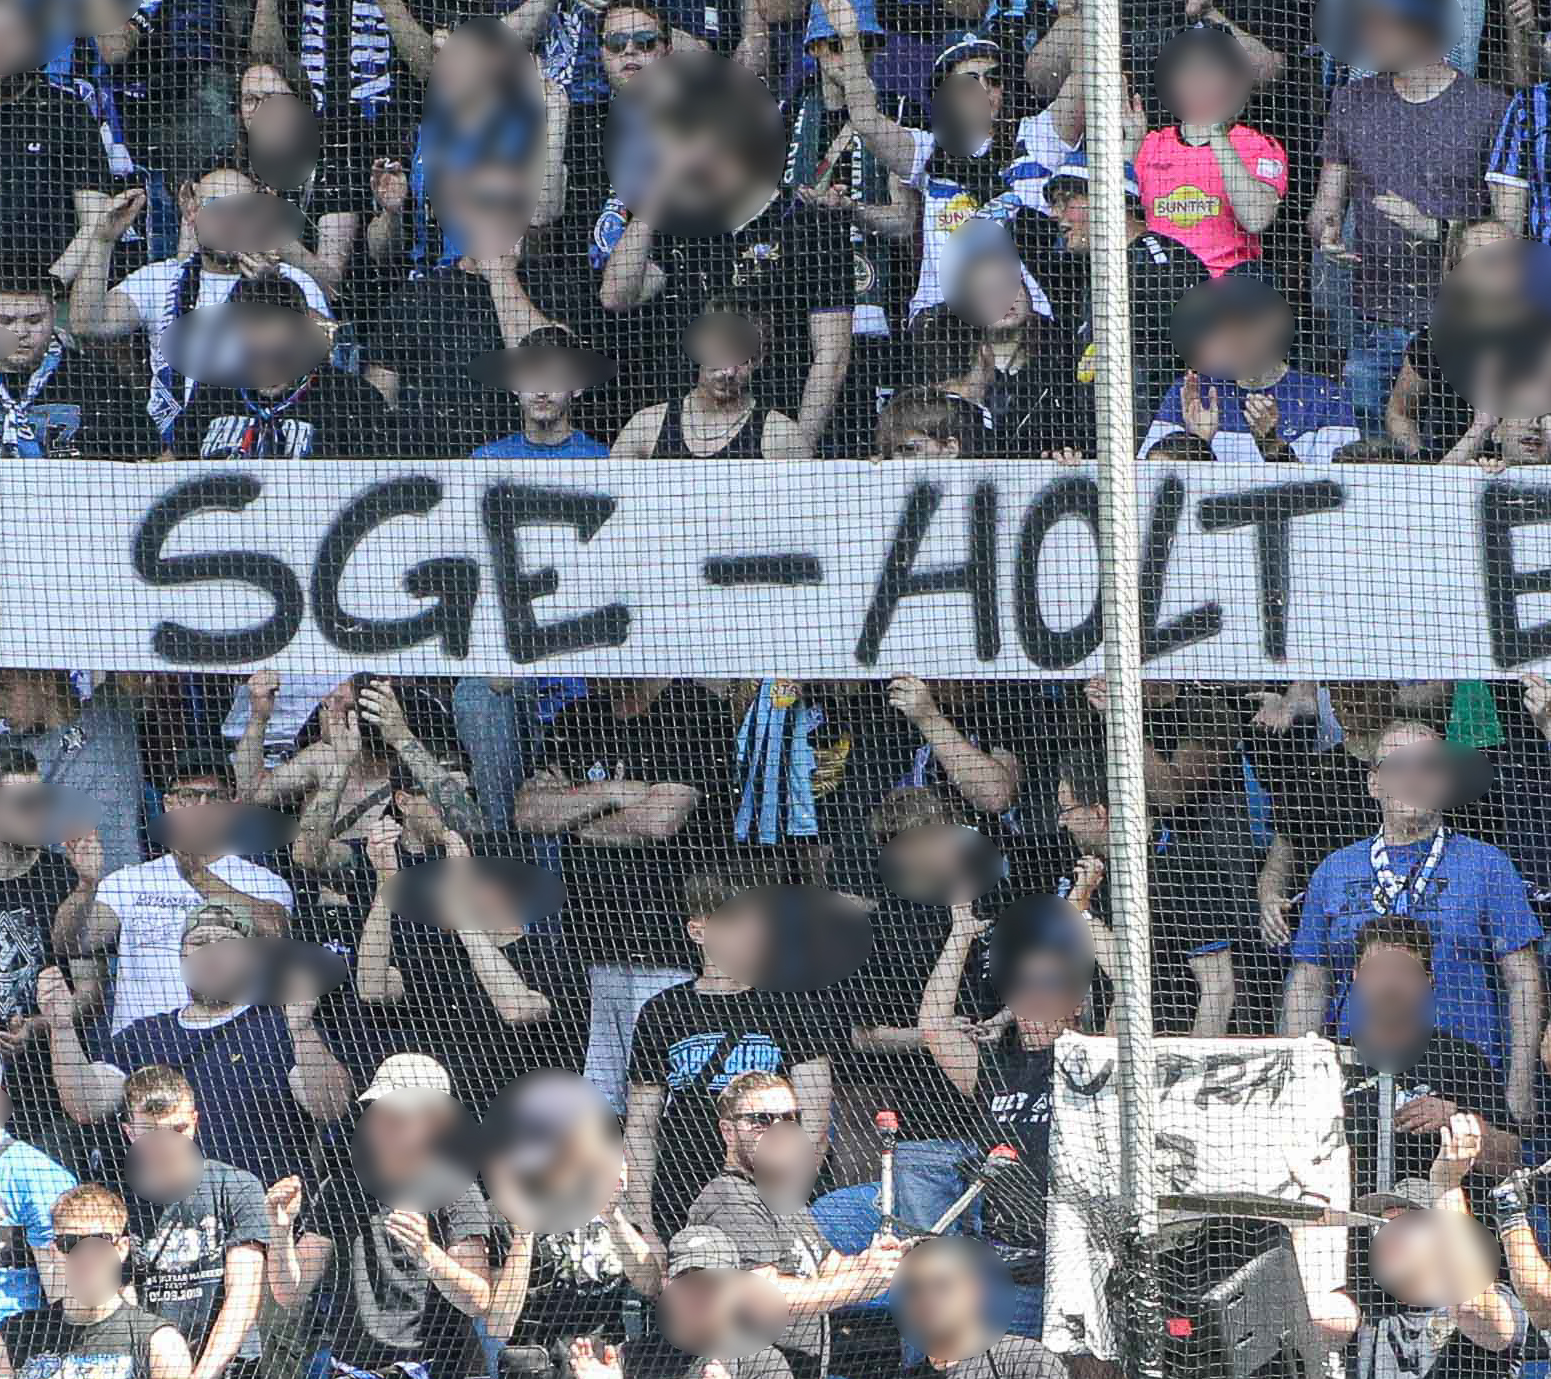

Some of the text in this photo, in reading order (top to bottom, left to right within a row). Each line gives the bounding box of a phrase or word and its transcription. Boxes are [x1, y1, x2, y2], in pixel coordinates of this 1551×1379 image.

[1158, 200, 1219, 215] SUNTAT
[133, 474, 629, 664] SGE
[856, 477, 1342, 670] HOLT
